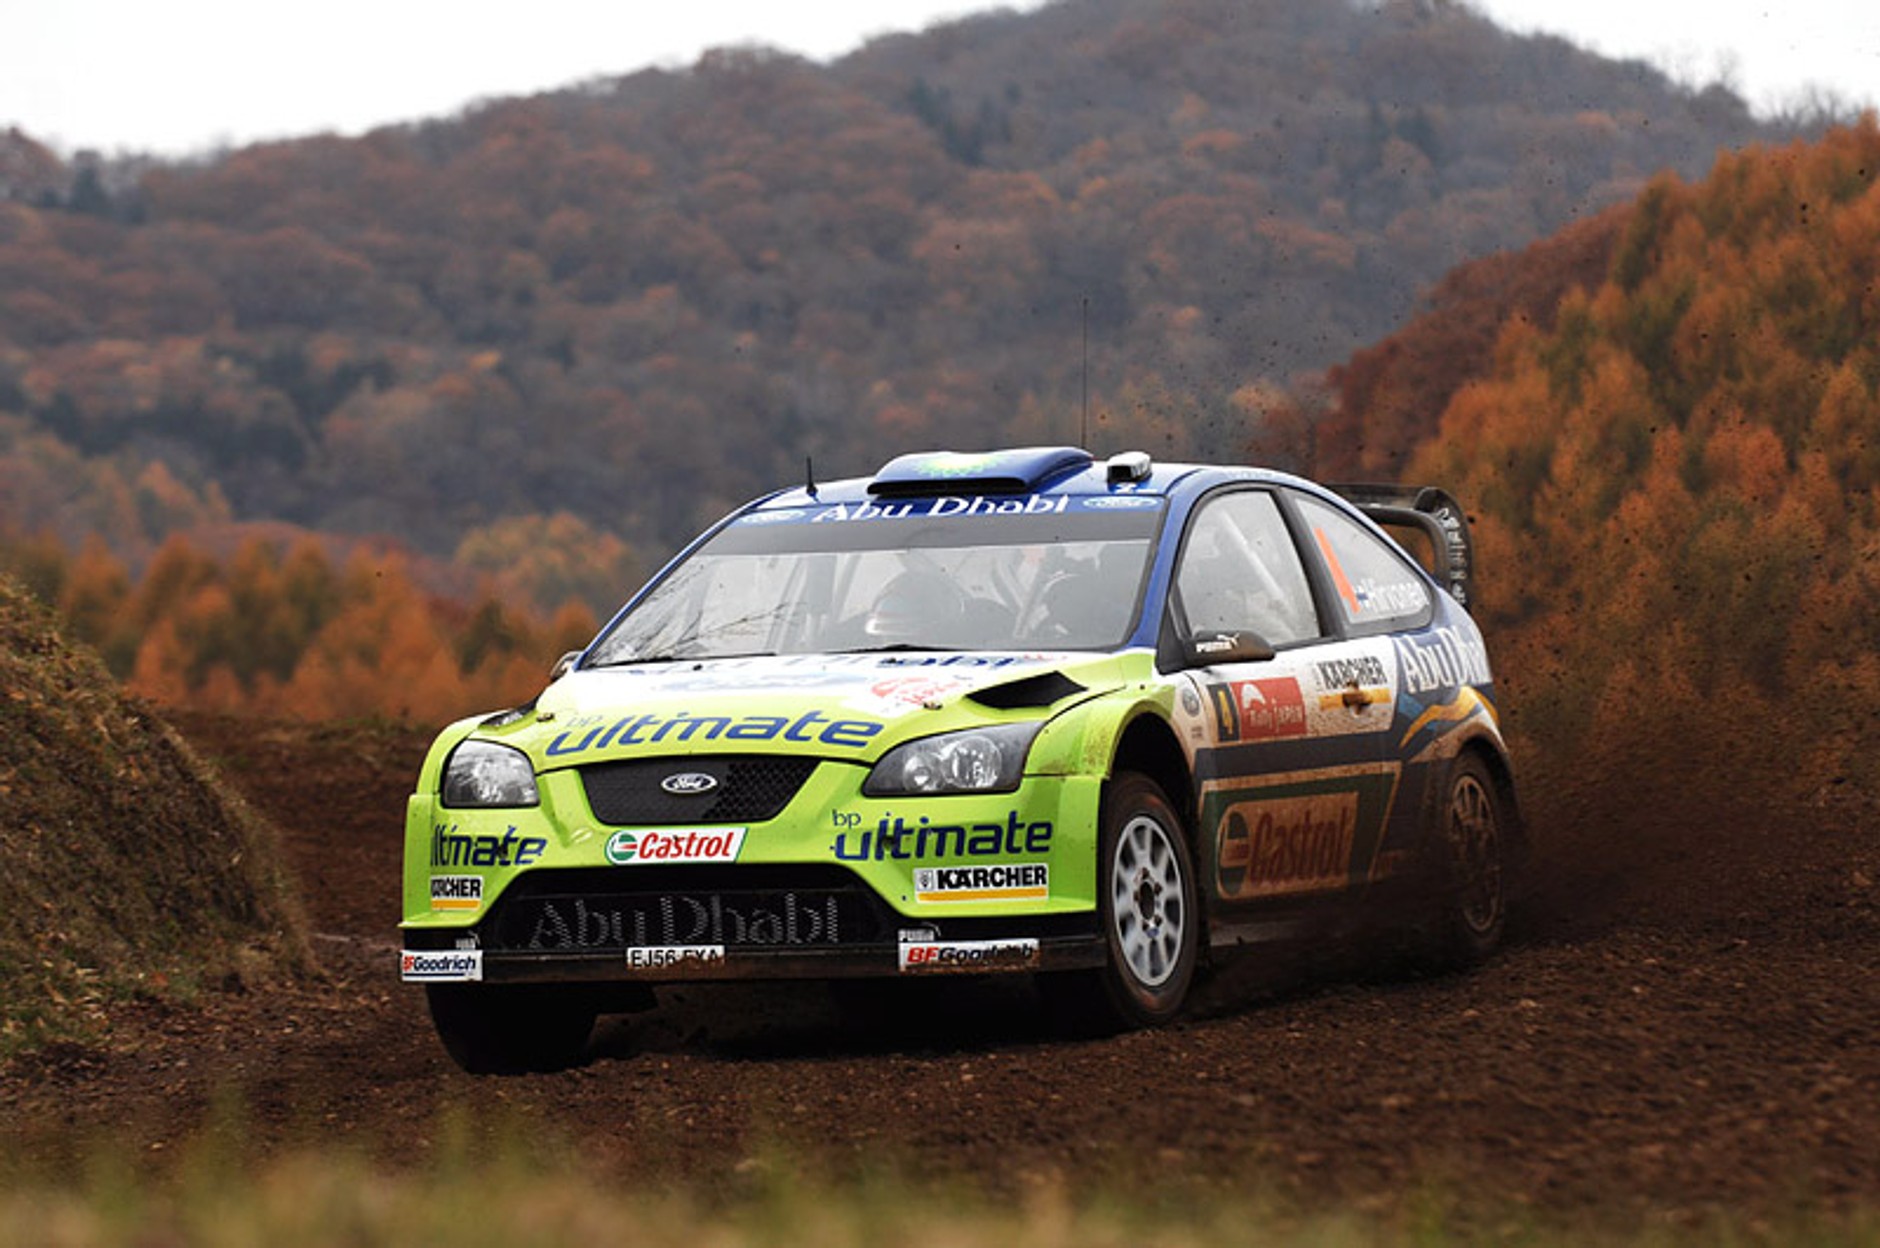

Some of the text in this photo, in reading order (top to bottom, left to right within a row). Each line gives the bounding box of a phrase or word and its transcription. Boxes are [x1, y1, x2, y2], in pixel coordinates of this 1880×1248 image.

[813, 501, 911, 522] Abu
[926, 494, 1067, 516] Dhabi
[1394, 634, 1456, 694] Abu
[545, 710, 884, 756] ultimate
[832, 809, 861, 830] bp
[834, 810, 1053, 861] ultimate
[639, 831, 734, 860] Castrol
[1248, 805, 1350, 887] Castrol
[937, 866, 1047, 890] KÄRCHER
[528, 893, 838, 948] Abu Dhabi
[631, 949, 676, 968] EJ56
